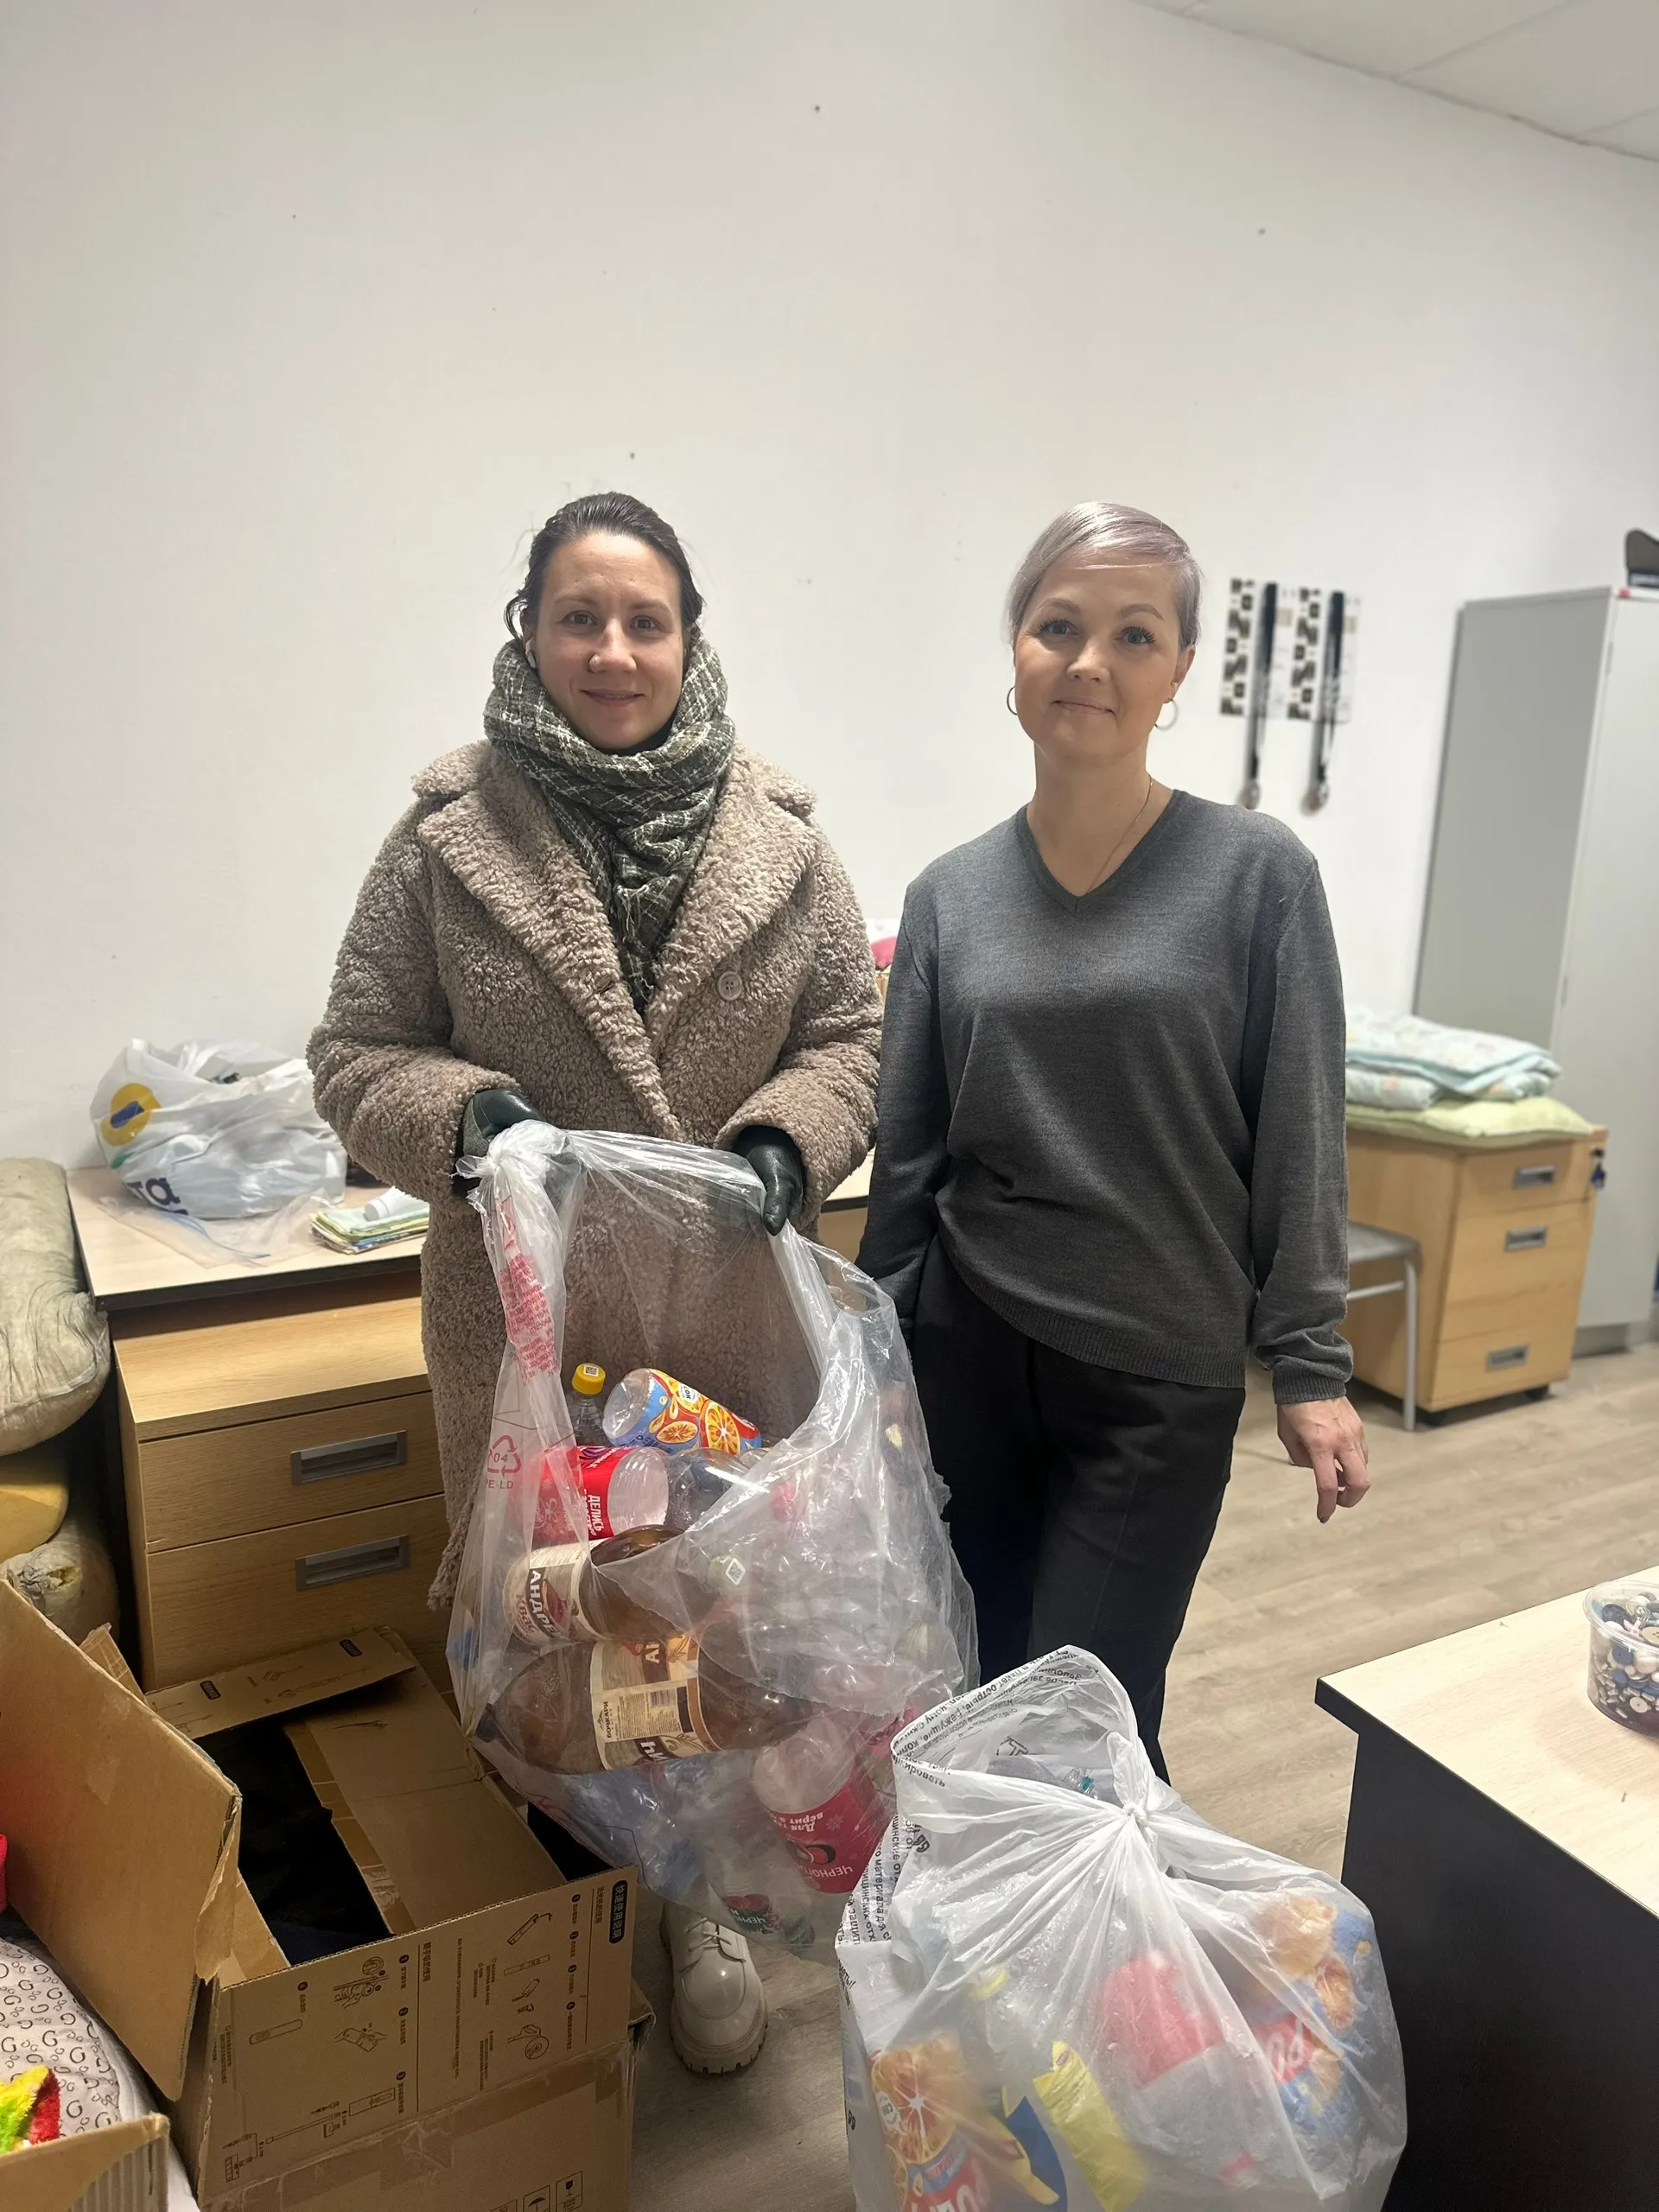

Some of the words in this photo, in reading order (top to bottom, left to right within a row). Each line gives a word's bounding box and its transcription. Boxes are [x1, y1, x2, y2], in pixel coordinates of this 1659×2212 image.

[493, 1452, 508, 1463] 04
[588, 1495, 604, 1531] ДЕЛИСЬ
[529, 1569, 555, 1633] АНДРЕ
[603, 1700, 612, 1738] БОЧКАРИ
[791, 1821, 815, 1833] Для
[891, 1813, 900, 1860] цинские
[873, 1859, 884, 1915] материала
[613, 1885, 626, 1940] 快速使用说明
